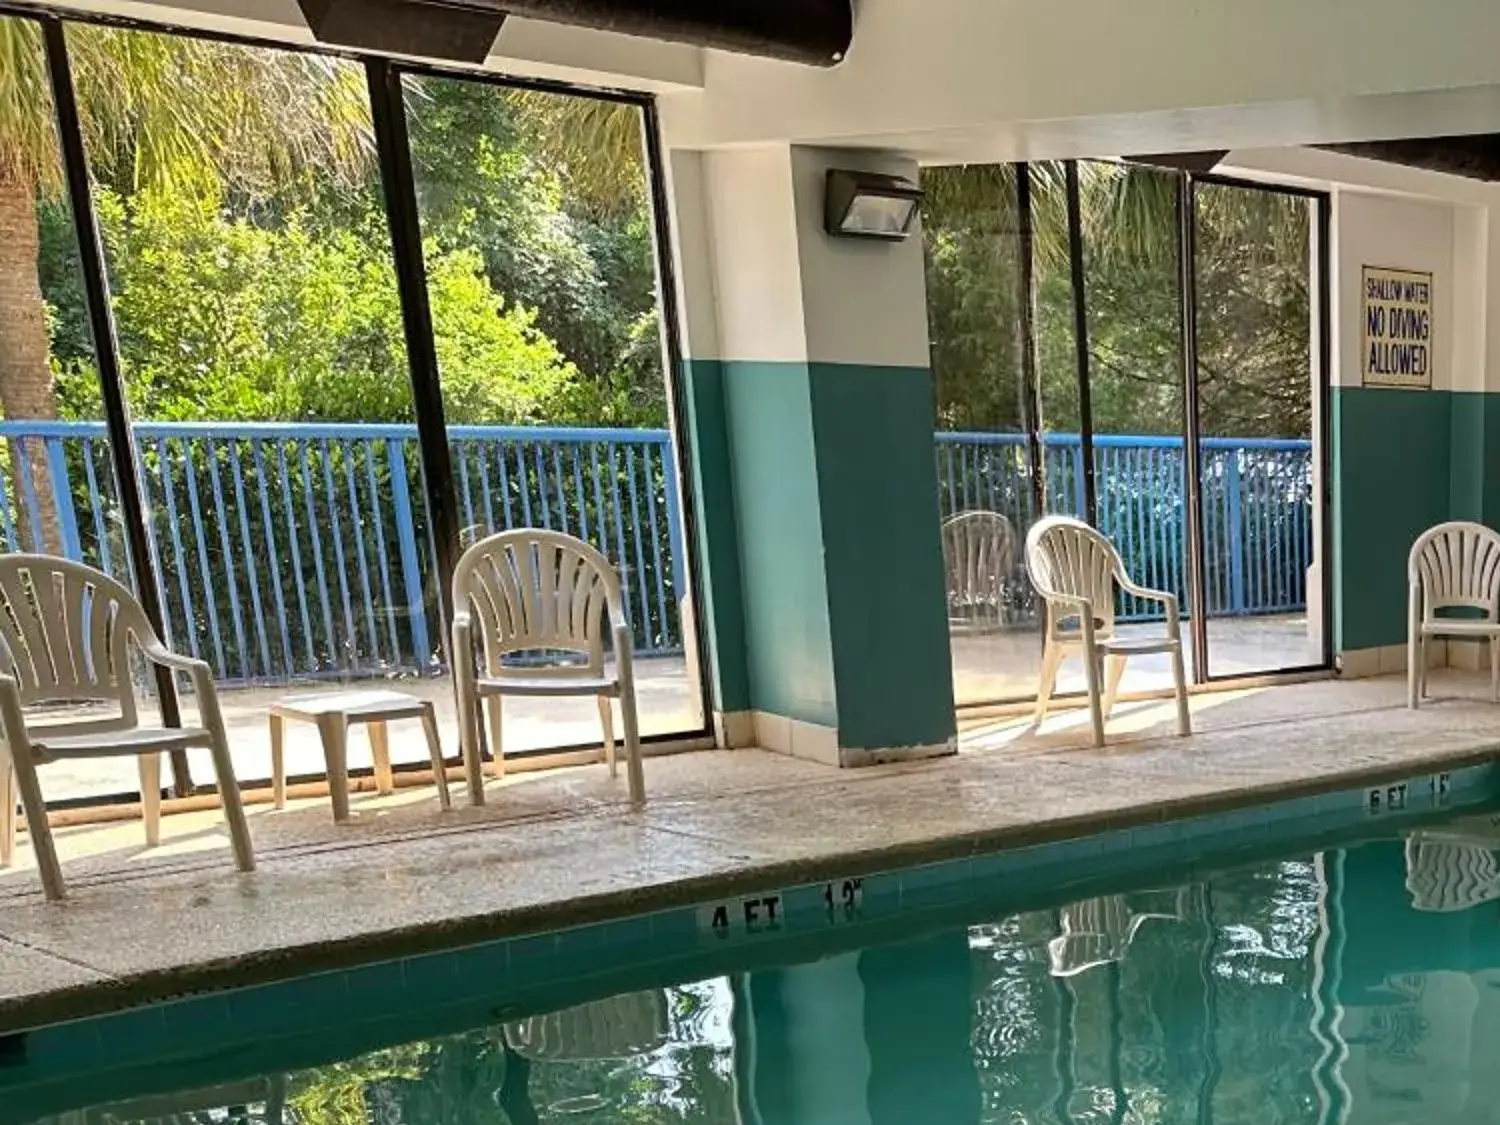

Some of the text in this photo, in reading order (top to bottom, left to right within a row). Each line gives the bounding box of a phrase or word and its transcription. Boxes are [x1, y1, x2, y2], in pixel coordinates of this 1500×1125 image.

[1367, 277, 1429, 304] SHALLOW WATER
[1367, 305, 1429, 341] NO DIVING
[1368, 342, 1428, 377] ALLOWED
[743, 896, 779, 923] FT
